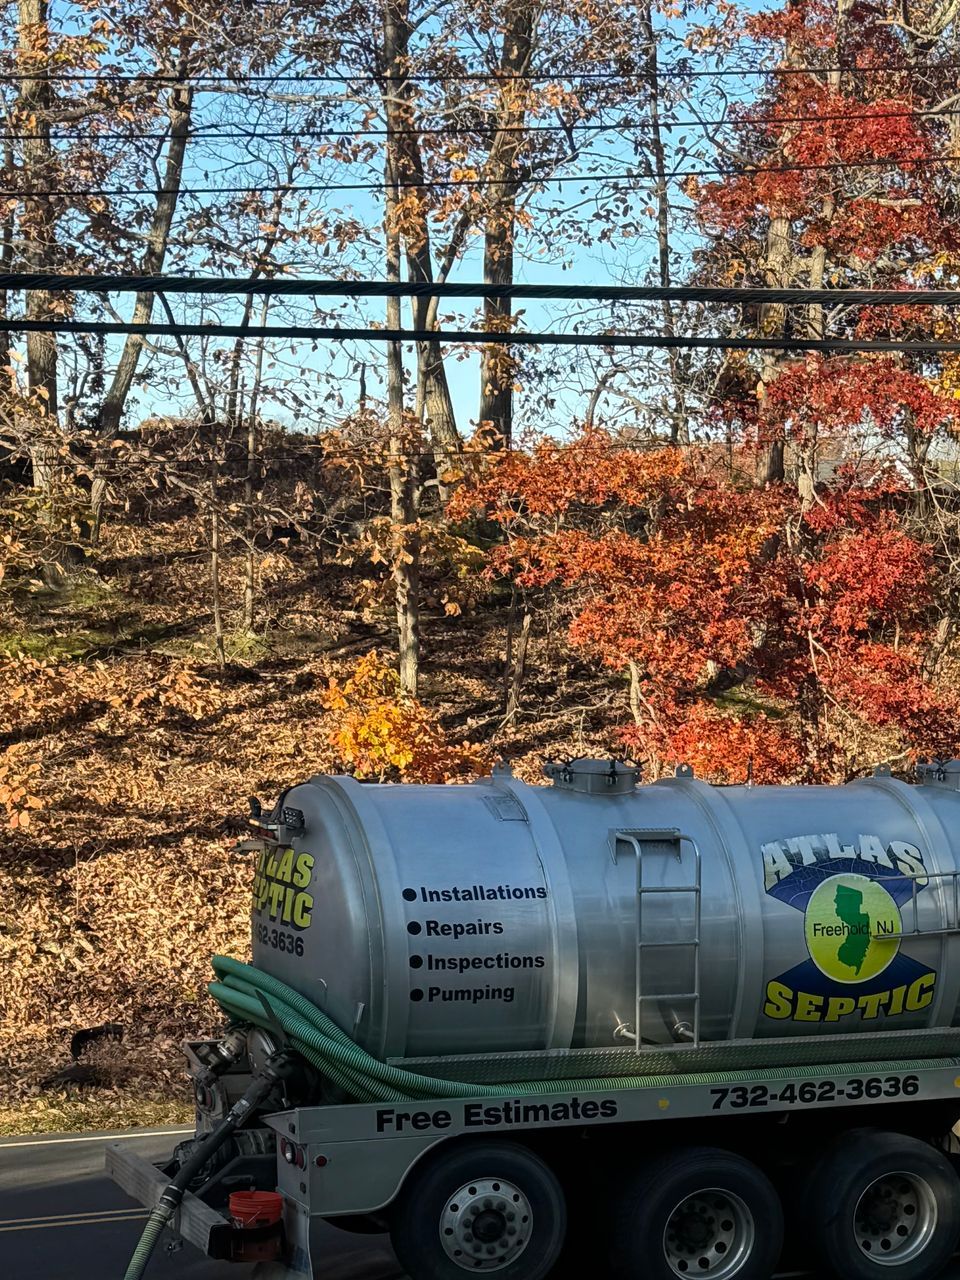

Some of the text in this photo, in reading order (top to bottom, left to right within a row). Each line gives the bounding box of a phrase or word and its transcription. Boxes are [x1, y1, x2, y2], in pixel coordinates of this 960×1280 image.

[760, 832, 929, 893] ATLAS
[421, 885, 547, 902] Installations
[426, 920, 504, 939] Repairs
[877, 921, 894, 934] NJ
[427, 954, 545, 973] Inspections
[428, 986, 515, 1002] Pumping
[763, 972, 937, 1022] SEPTIC
[709, 1074, 920, 1110] 732-462-3636
[376, 1098, 618, 1132] Free Estimates
